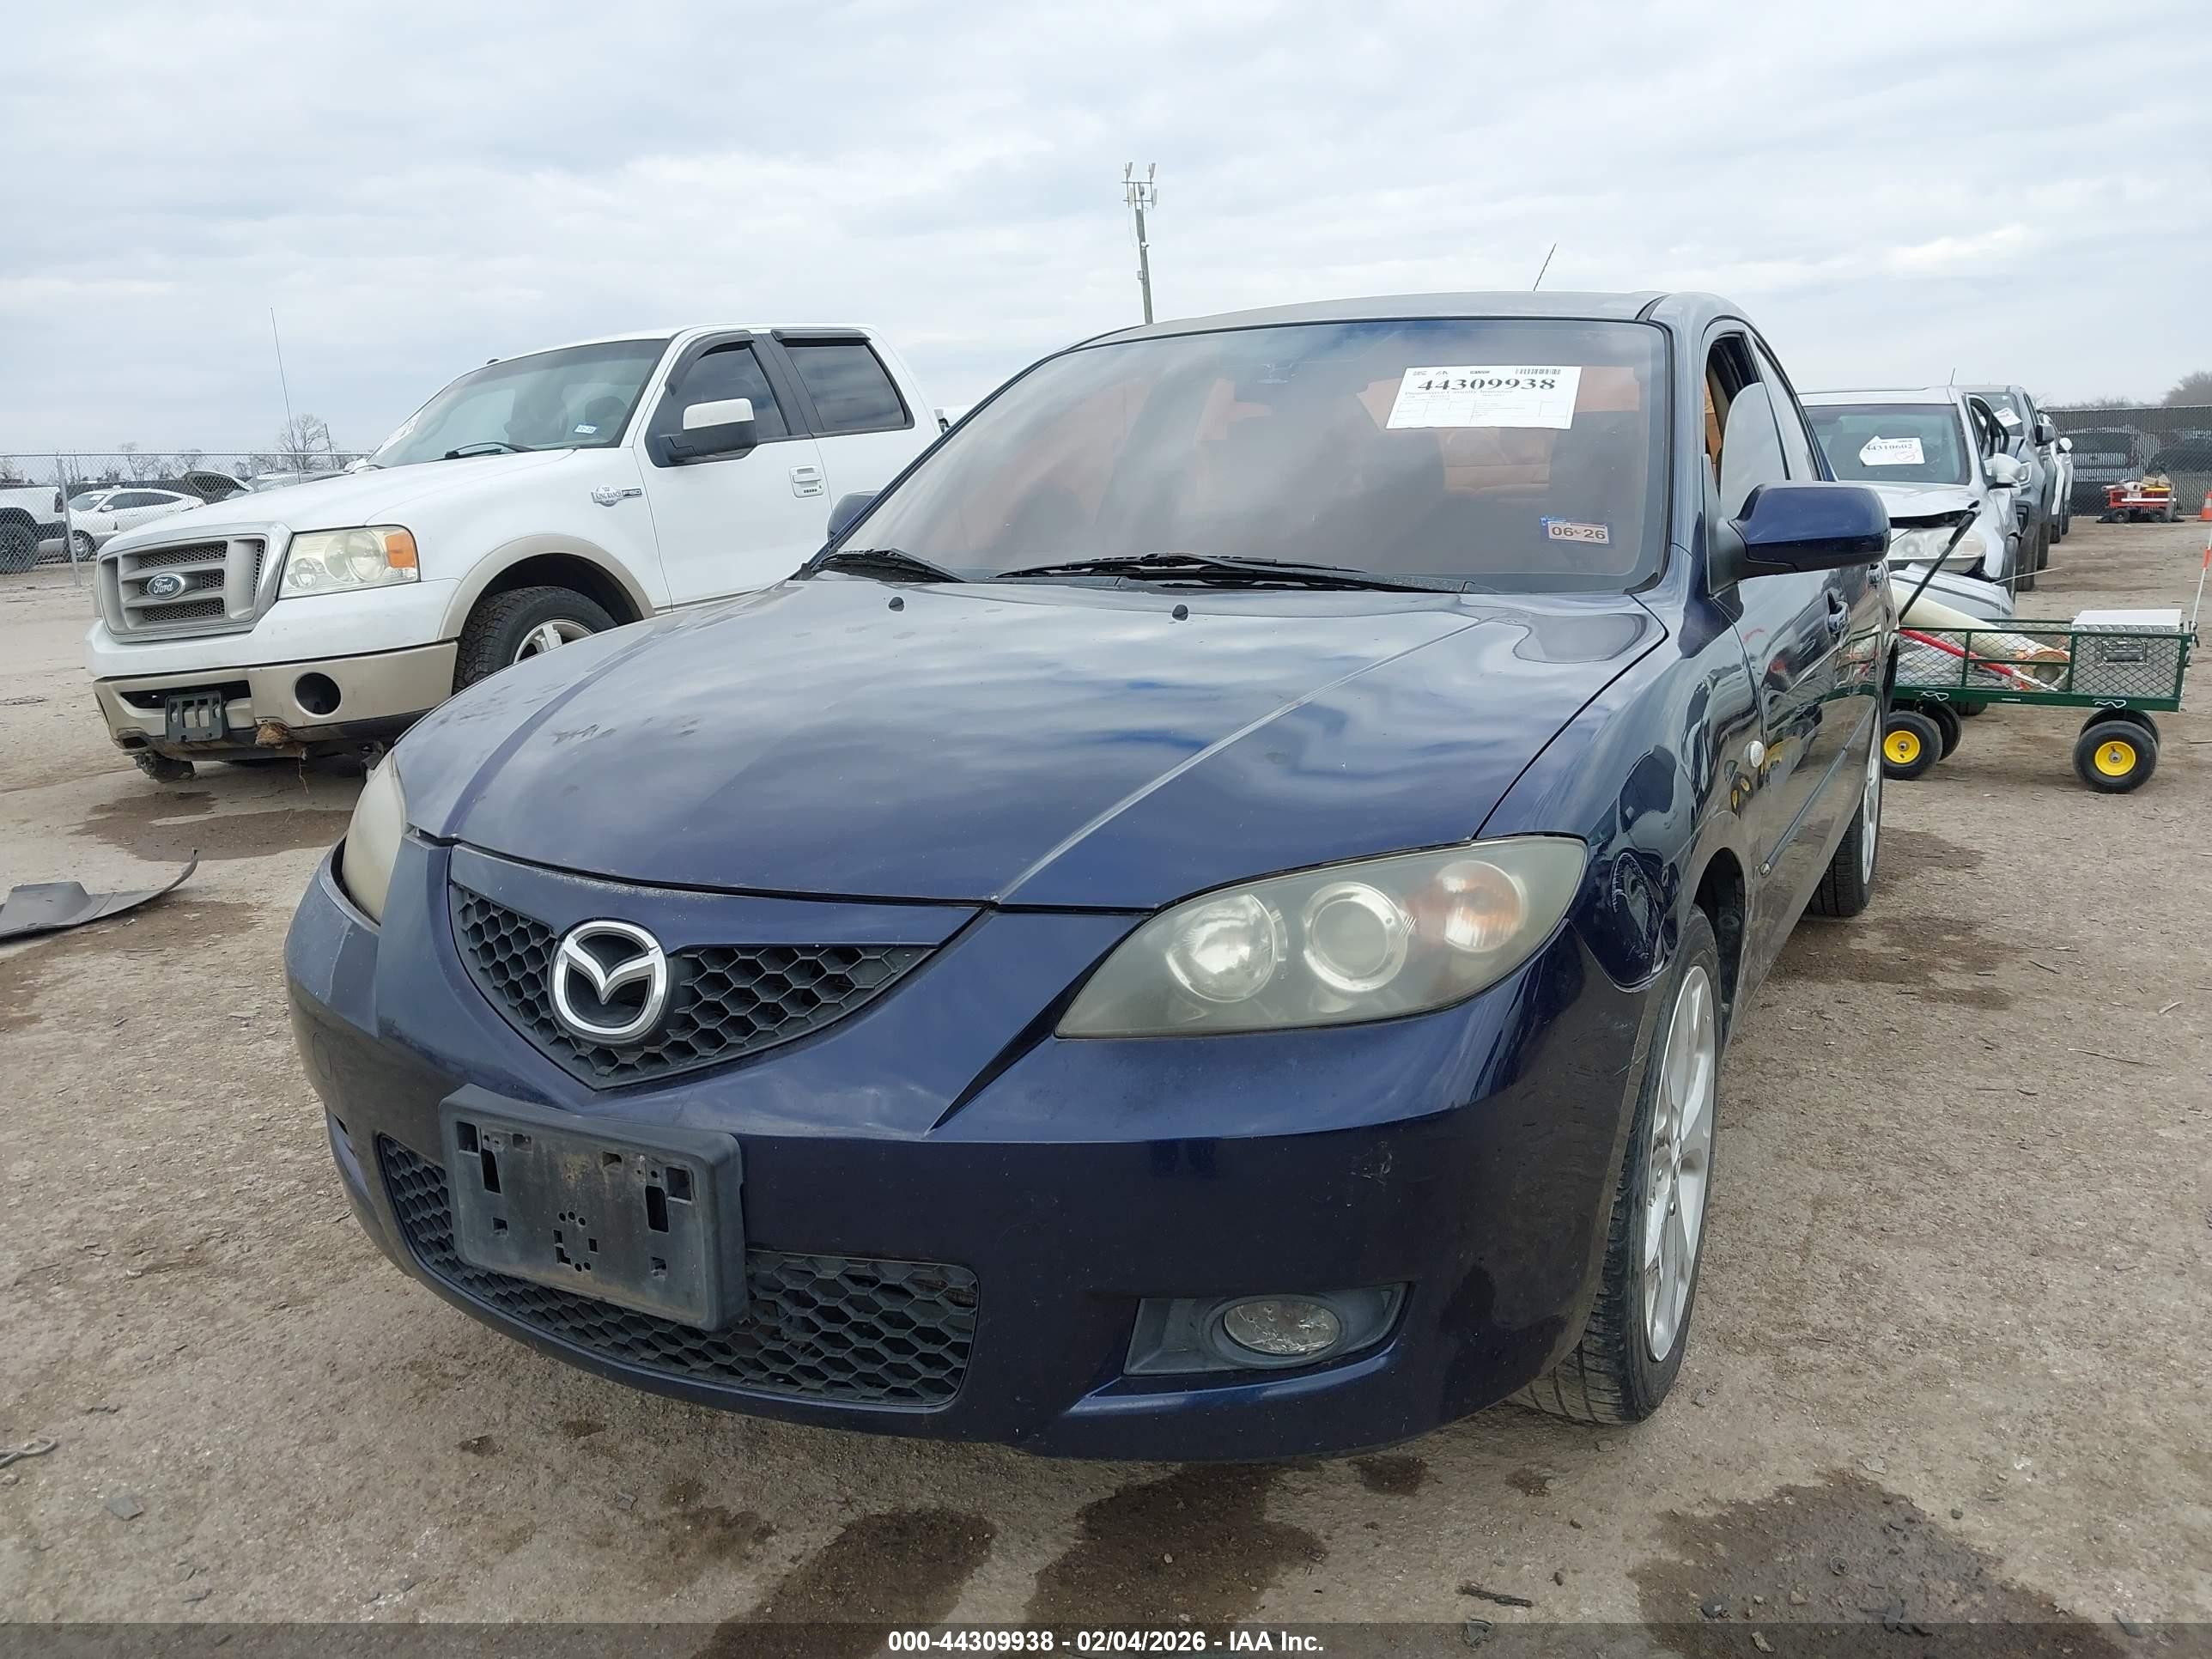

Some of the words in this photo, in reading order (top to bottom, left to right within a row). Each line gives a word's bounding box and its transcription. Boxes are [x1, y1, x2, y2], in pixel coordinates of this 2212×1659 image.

[1417, 379, 1556, 391] 44309938
[1552, 526, 1574, 537] 06
[1583, 529, 1607, 540] 26
[153, 578, 173, 594] Ford
